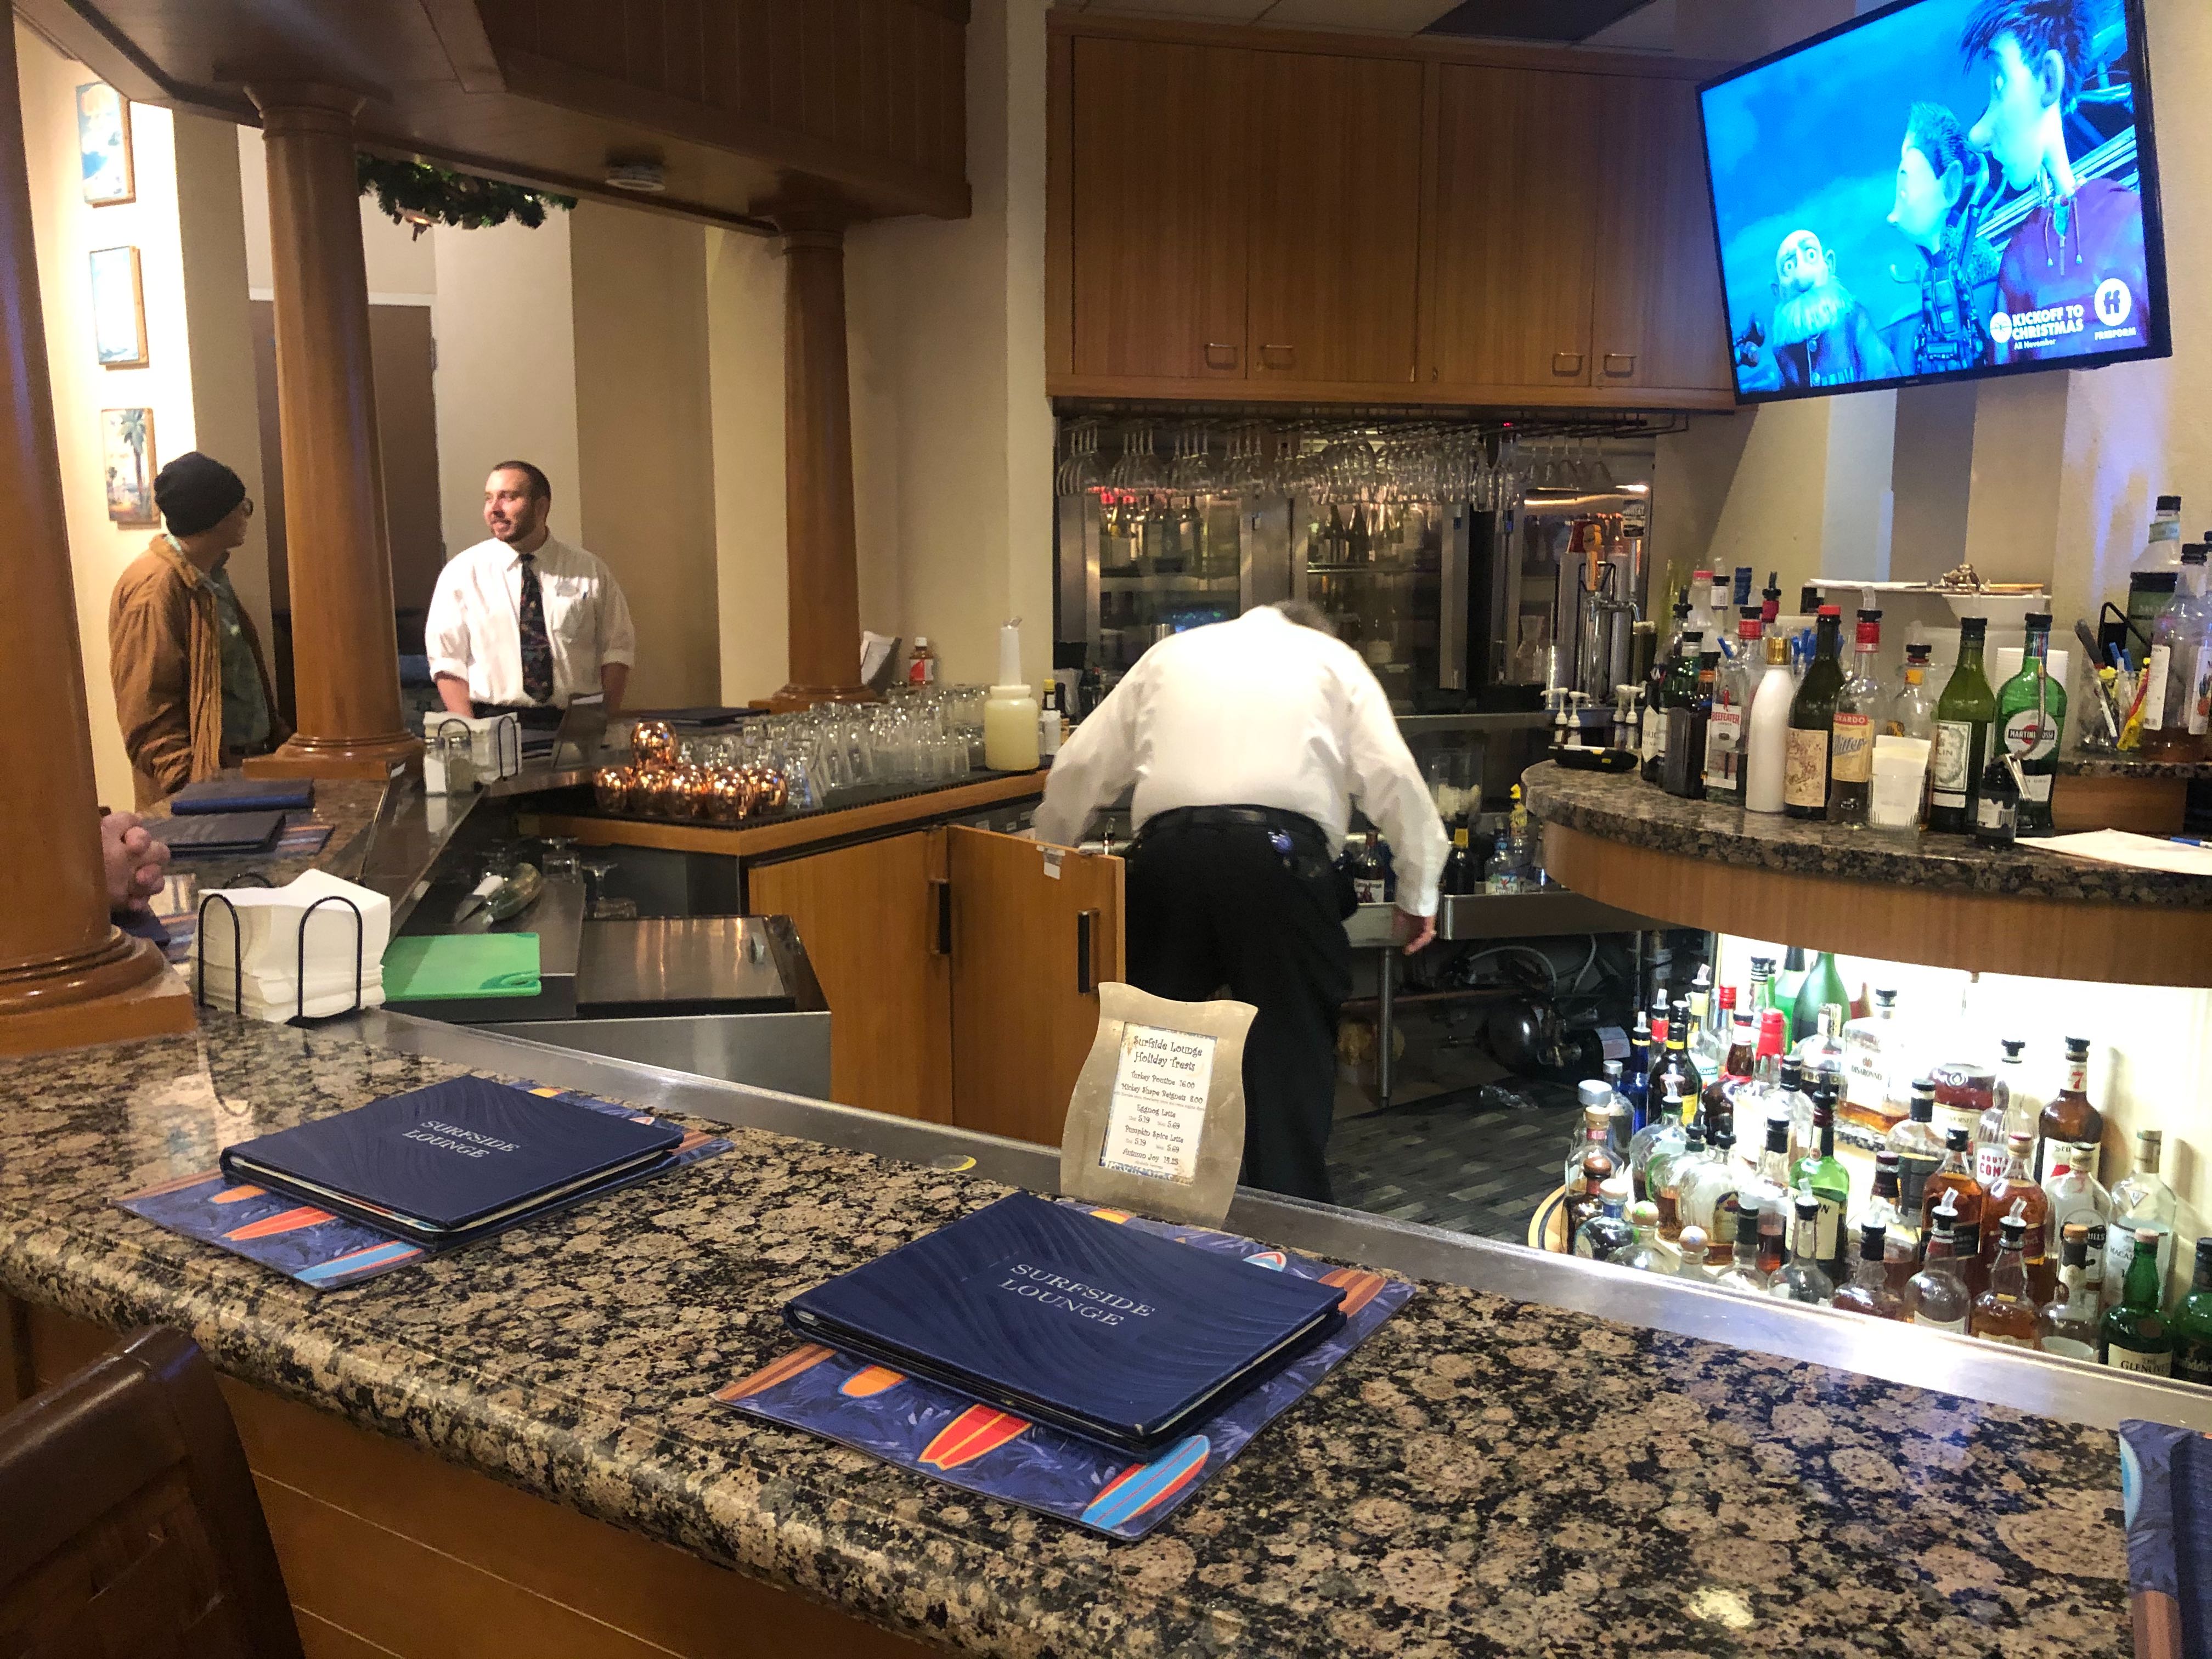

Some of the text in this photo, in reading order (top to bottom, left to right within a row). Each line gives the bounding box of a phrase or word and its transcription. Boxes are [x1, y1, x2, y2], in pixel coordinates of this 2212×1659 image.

[2012, 304, 2084, 327] KICKOFF TO
[2012, 318, 2084, 341] CHRISTMAS
[2094, 327, 2136, 340] FREEFORM
[2014, 338, 2056, 350] All November
[1712, 711, 1740, 724] BEEFEATER
[2010, 730, 2036, 739] MARTINI
[1133, 1035, 1203, 1058] Surfside Lounge
[1133, 1051, 1195, 1071] Holiday Treats
[1131, 1070, 1150, 1082] Turkey
[1152, 1074, 1175, 1086] Poutine
[1851, 1064, 1882, 1081] DISARONNO
[2072, 1071, 2084, 1089] 7
[1121, 1082, 1141, 1093] Mickey
[1142, 1086, 1160, 1097] Shape
[1162, 1090, 1186, 1101] Beignets
[1137, 1104, 1160, 1116] Eggnog
[1161, 1108, 1176, 1118] Latte
[420, 1120, 520, 1152] SURFSIDE
[1125, 1125, 1184, 1143] Pumpkin Spice Latte
[402, 1129, 490, 1158] LOUNGE
[1122, 1148, 1146, 1159] Autumn
[1148, 1154, 1160, 1163] Joy
[1009, 1263, 1155, 1317] SURFSIDE
[998, 1278, 1124, 1325] LOUNGE
